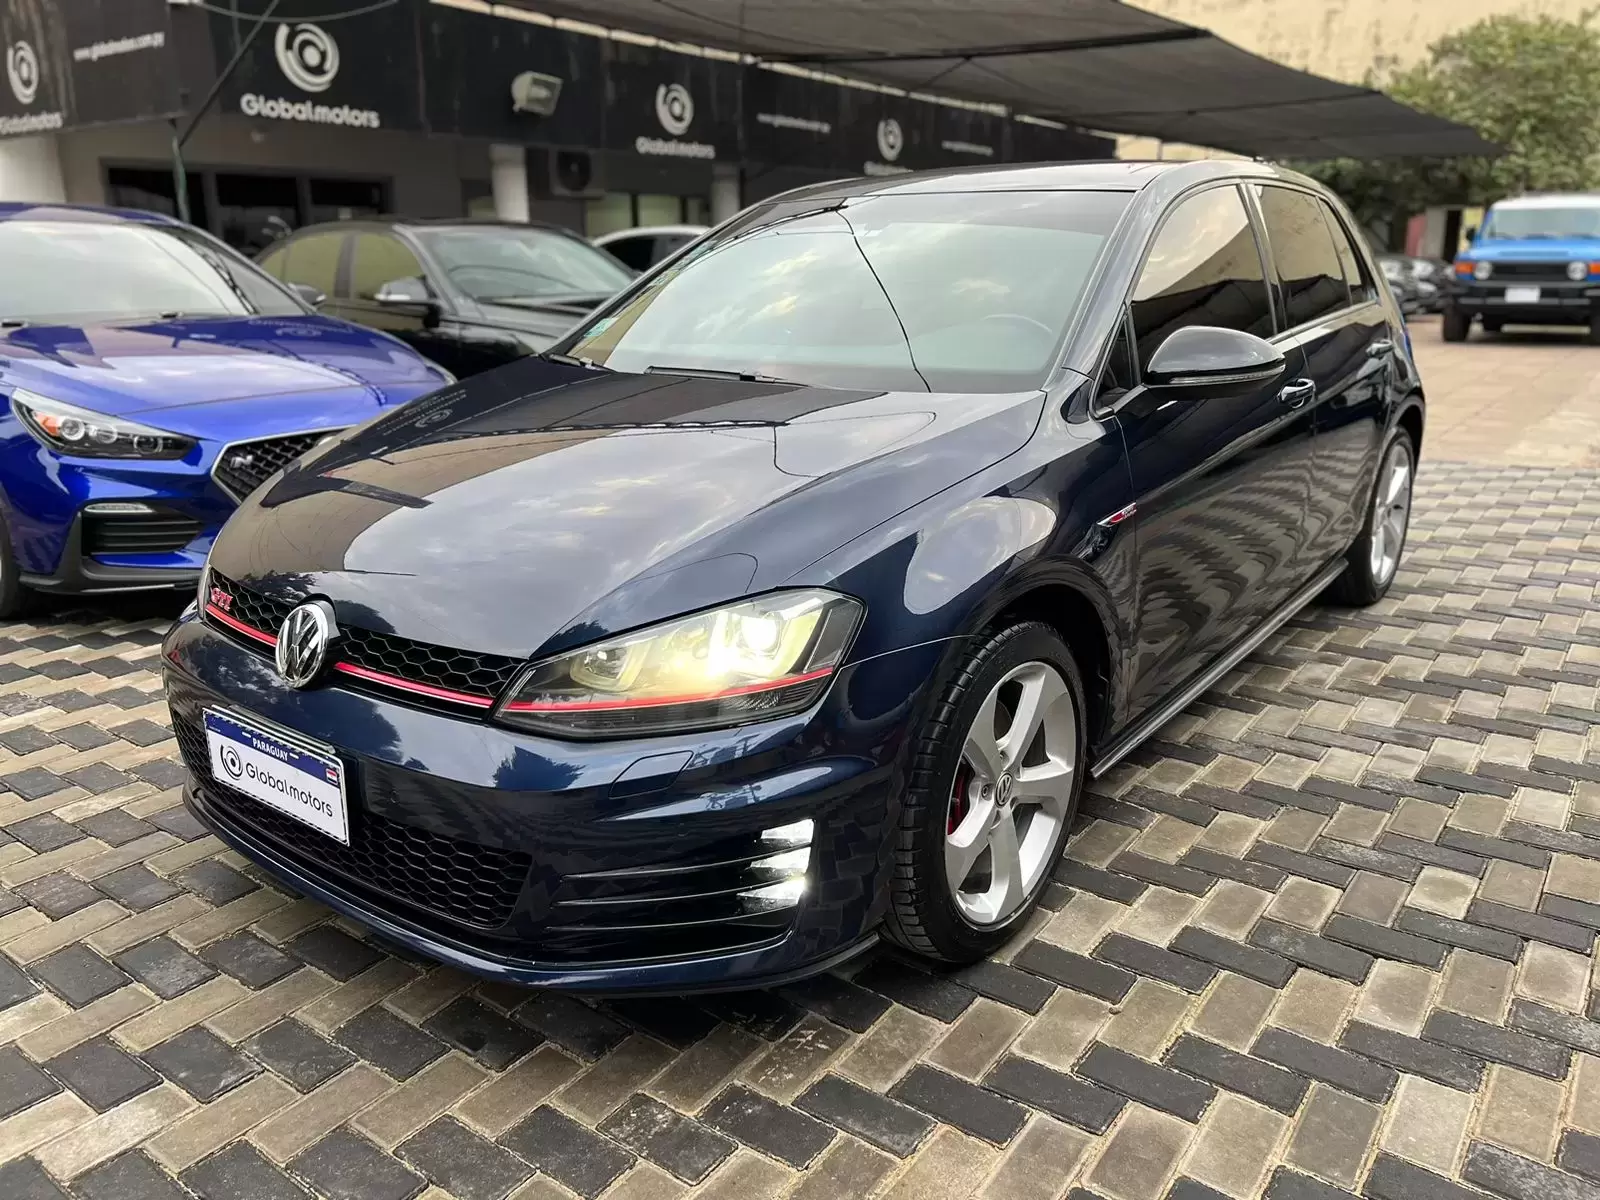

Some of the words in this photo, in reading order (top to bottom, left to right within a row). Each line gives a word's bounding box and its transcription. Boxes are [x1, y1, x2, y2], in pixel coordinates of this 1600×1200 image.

[240, 92, 380, 128] Globalmotors
[211, 587, 234, 612] GTI
[252, 737, 289, 762] PARAGUAY
[245, 762, 334, 818] Globalmotors
